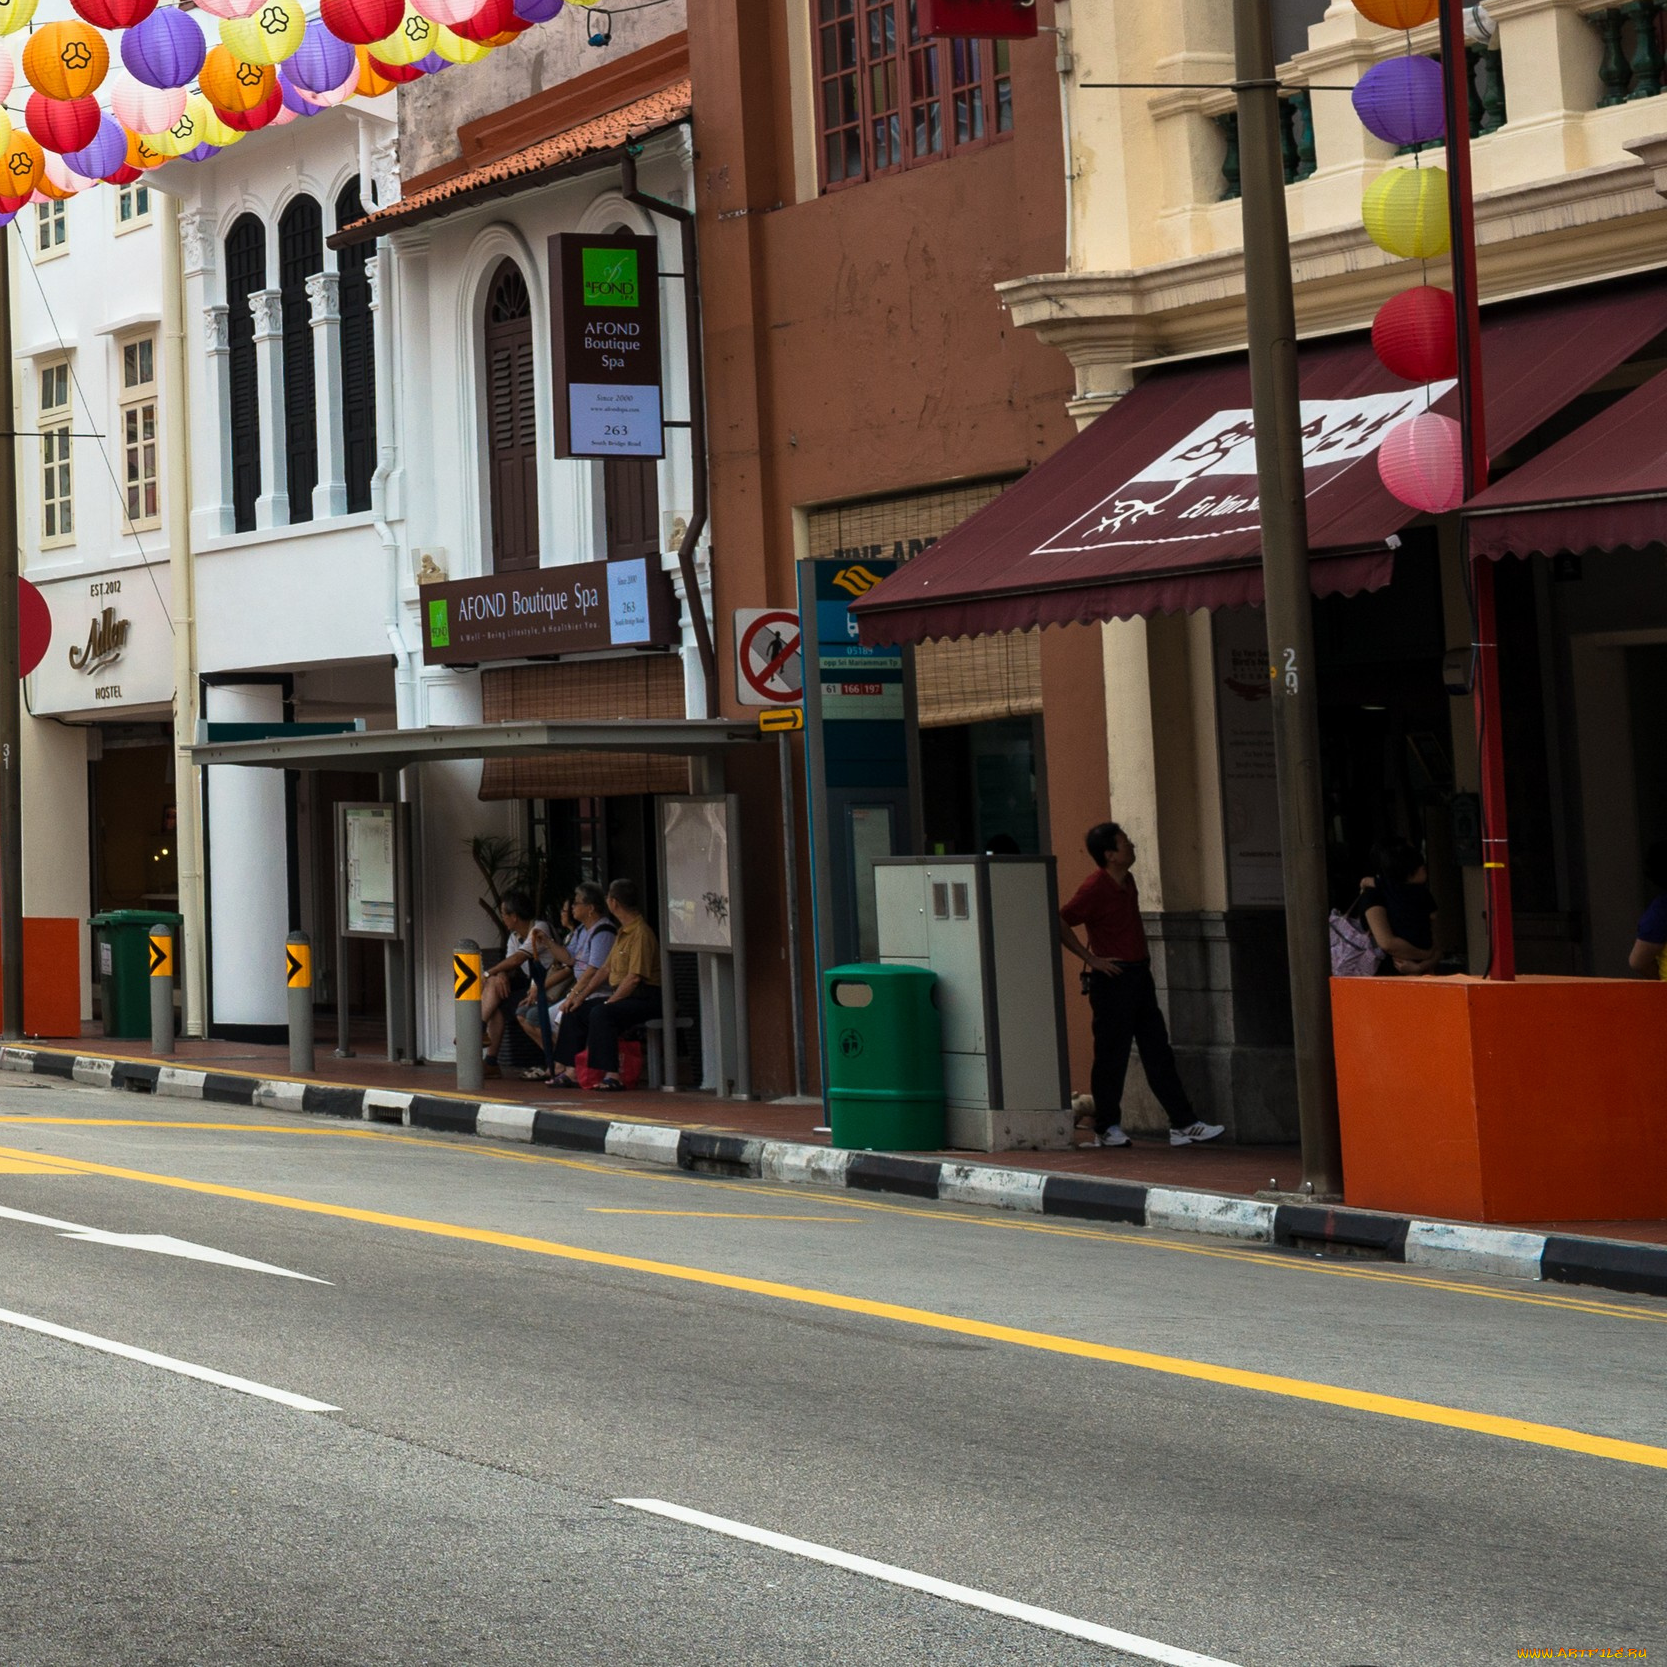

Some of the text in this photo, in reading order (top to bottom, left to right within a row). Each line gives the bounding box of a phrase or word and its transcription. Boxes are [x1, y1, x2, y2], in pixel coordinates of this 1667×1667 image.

[584, 322, 640, 335] AFOND
[584, 336, 640, 353] Boutique
[601, 354, 625, 370] Spa
[604, 425, 628, 435] 263
[90, 580, 121, 597] EST.2012
[459, 583, 599, 622] AFOND Boutique Spa
[622, 602, 636, 614] 263
[889, 659, 898, 667] Tp
[1283, 647, 1299, 695] 29
[95, 685, 122, 700] HOSTEL
[826, 685, 880, 693] 61 166 197
[2, 743, 10, 769] 31
